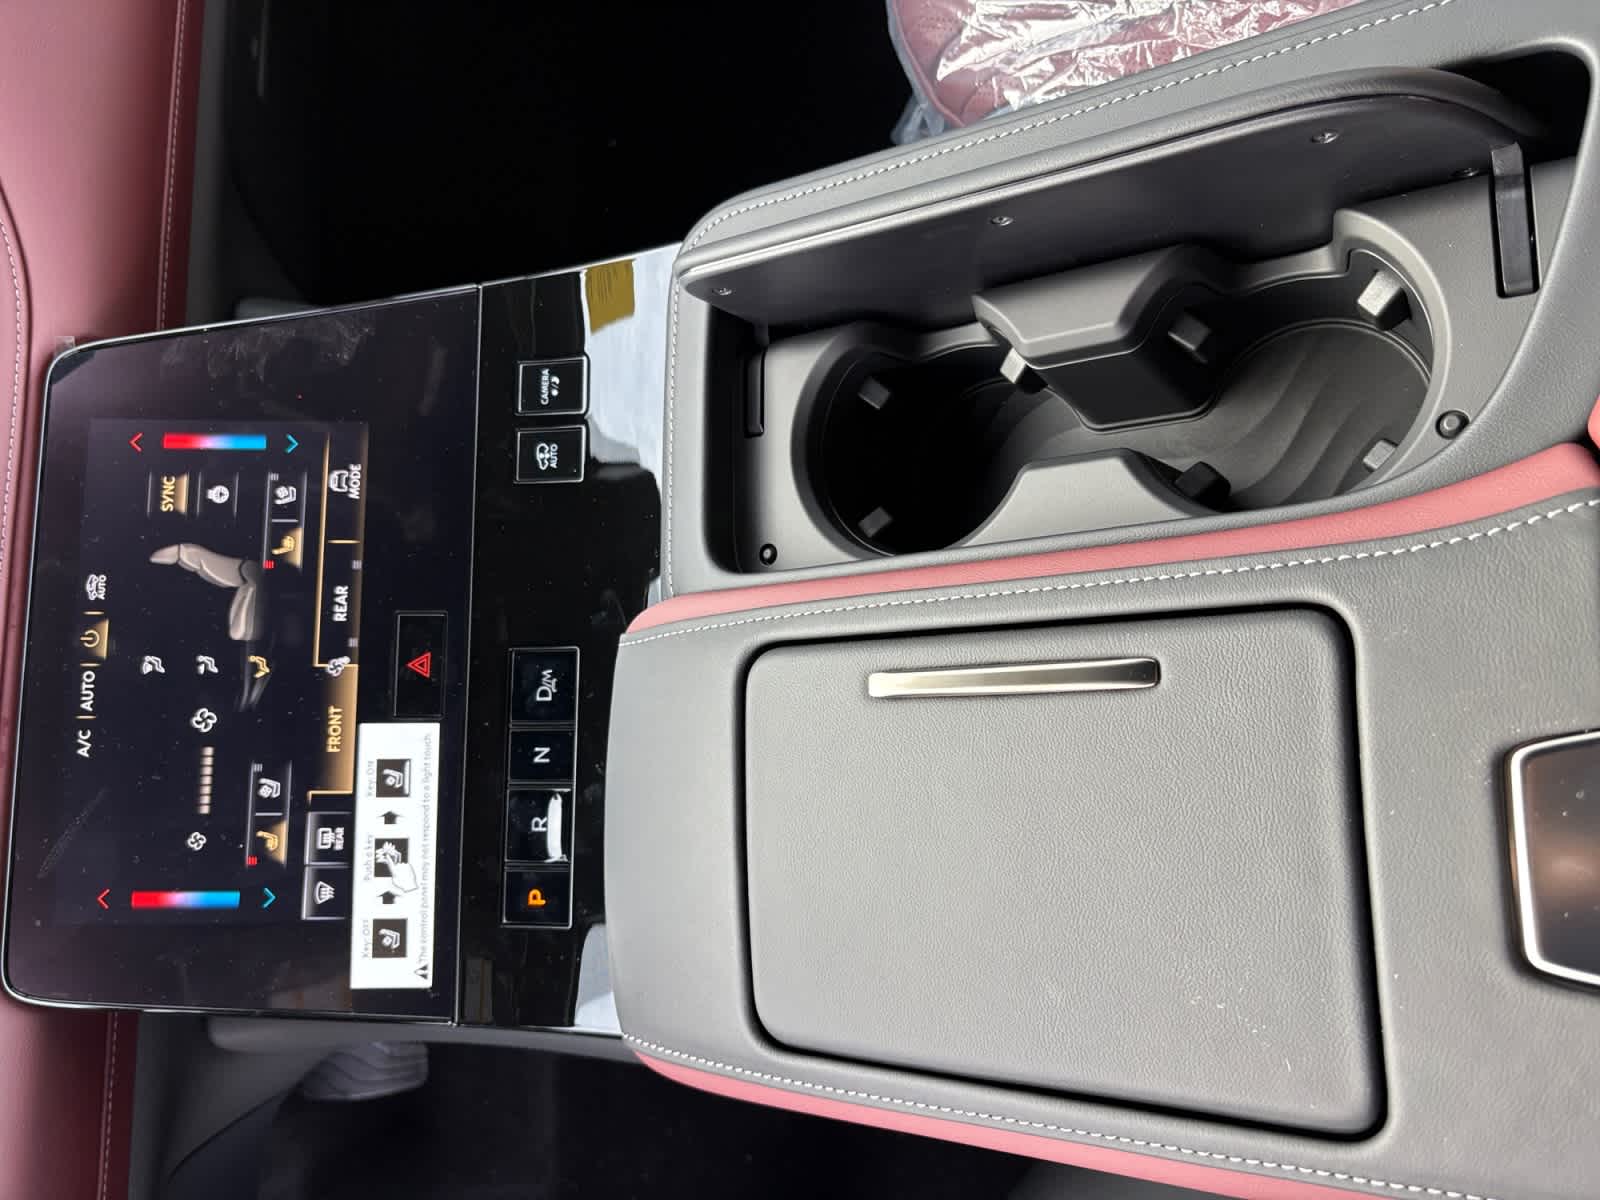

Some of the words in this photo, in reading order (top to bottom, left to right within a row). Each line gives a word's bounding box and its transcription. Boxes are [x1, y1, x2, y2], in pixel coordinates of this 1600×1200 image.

[540, 368, 550, 405] CAMERA
[550, 443, 558, 469] AUTO
[161, 476, 176, 512] SYNC
[349, 464, 362, 499] MODE
[97, 575, 107, 600] AUTO
[333, 586, 348, 622] REAR
[80, 671, 96, 711] AUTO
[326, 705, 343, 753] FRONT
[77, 728, 92, 758] A/C
[533, 747, 550, 763] N
[422, 763, 432, 783] light
[423, 792, 430, 803] to
[421, 804, 432, 841] respond
[531, 816, 547, 832] R
[335, 827, 345, 851] REAR
[421, 843, 429, 860] not
[362, 862, 373, 881] Push
[421, 861, 431, 881] may
[420, 882, 431, 909] panel
[528, 888, 546, 905] P
[419, 910, 428, 945] control
[418, 945, 428, 963] The
